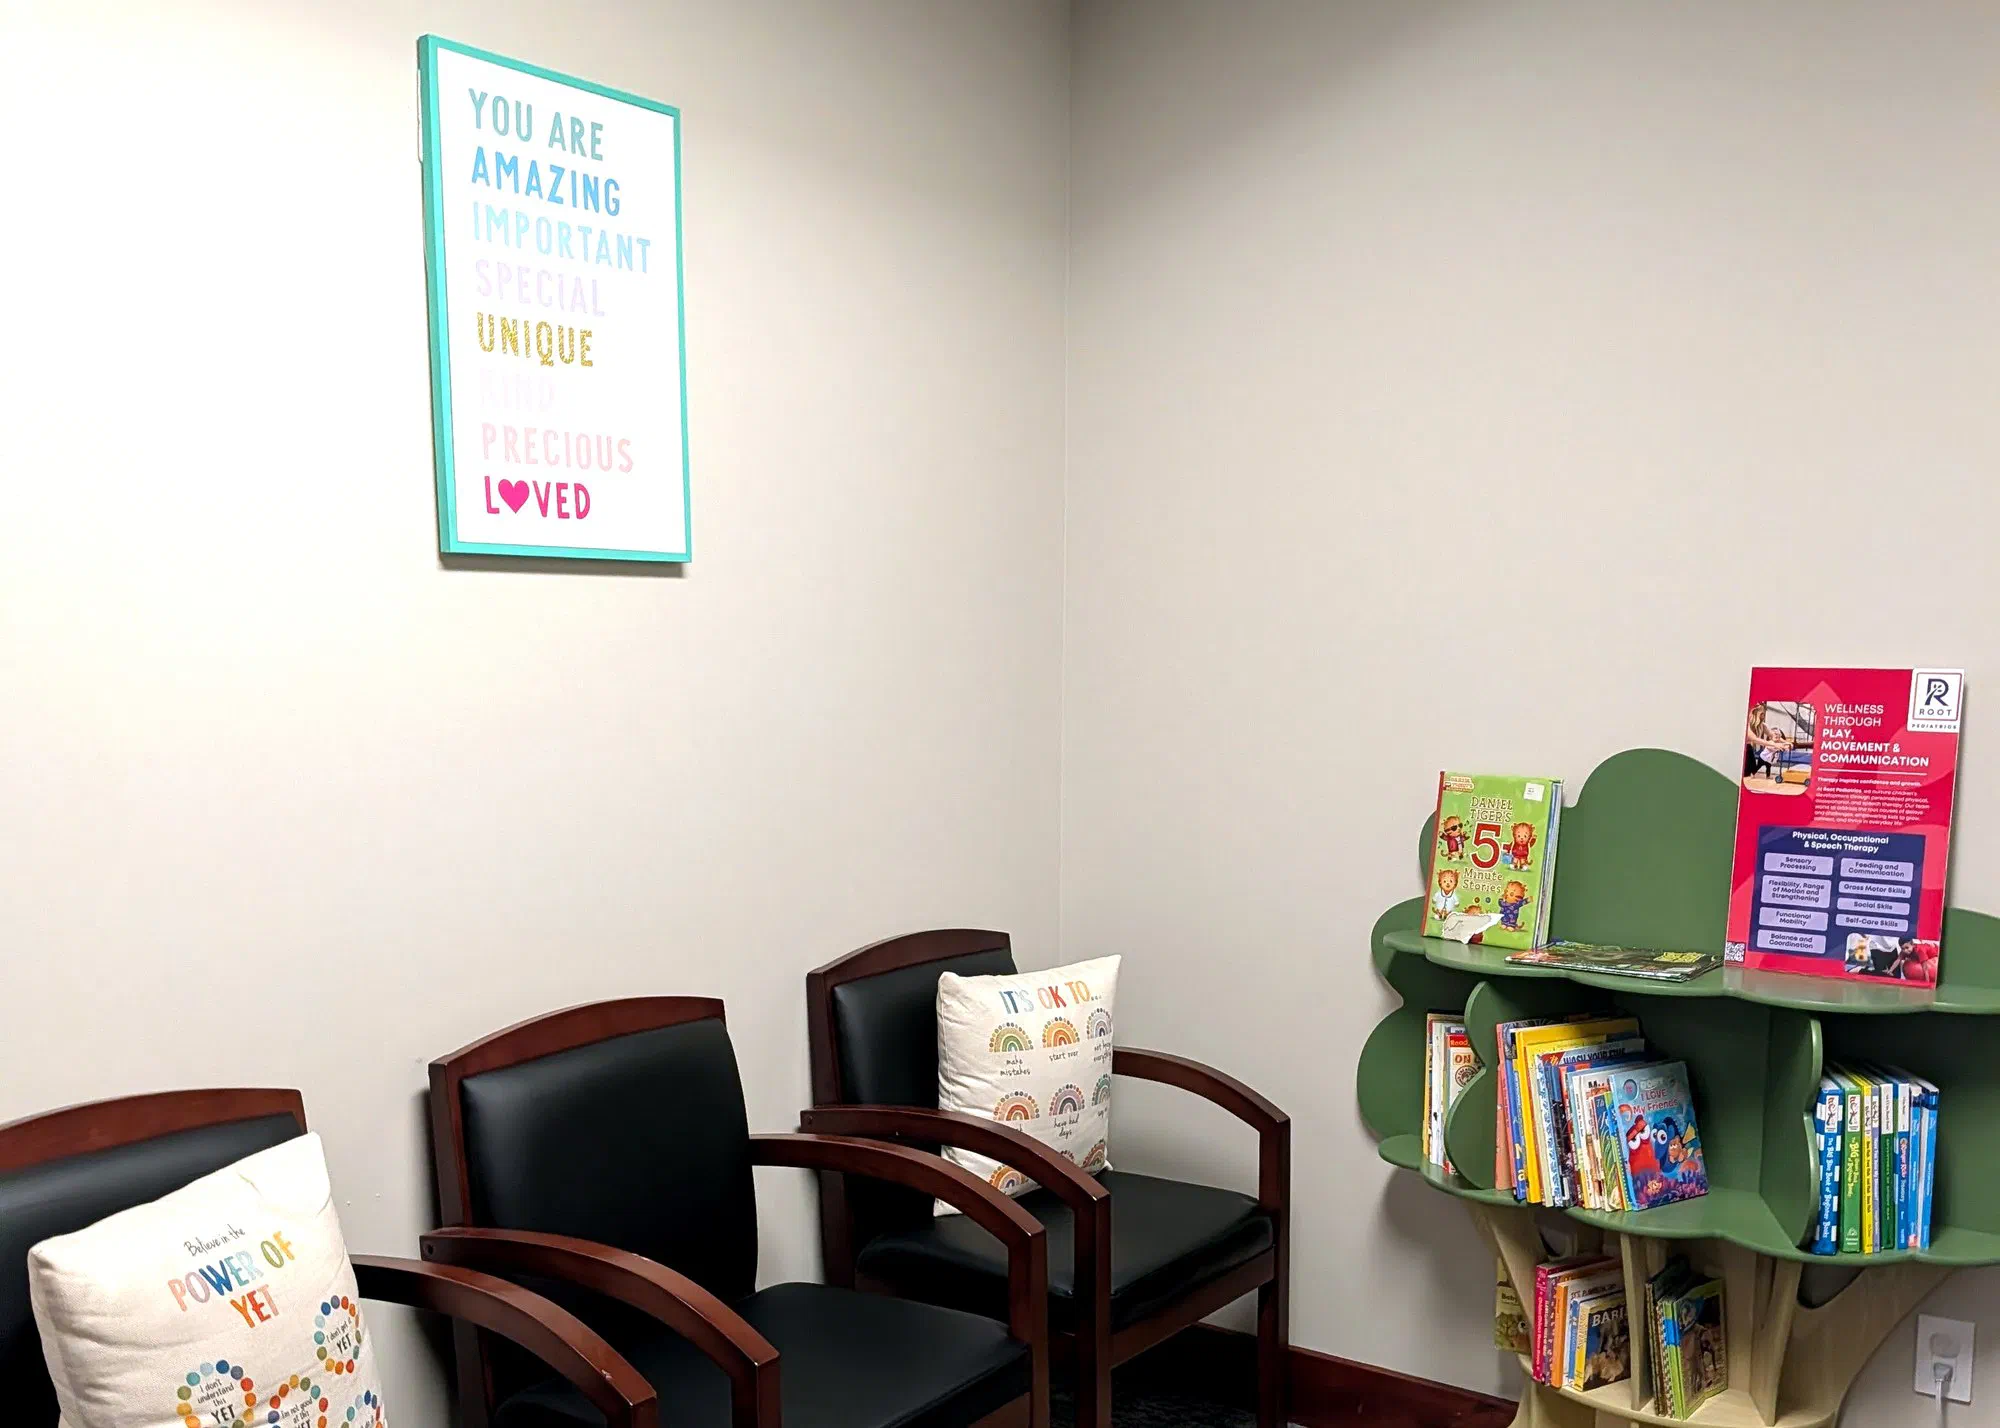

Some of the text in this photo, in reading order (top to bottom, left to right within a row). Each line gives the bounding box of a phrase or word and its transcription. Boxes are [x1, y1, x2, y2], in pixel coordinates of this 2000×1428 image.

[469, 88, 603, 161] YOU ARE
[471, 146, 620, 216] AMAZING
[473, 202, 651, 273] IMPORTANT
[476, 259, 605, 316] SPECIAL
[477, 312, 593, 367] UNIQUE
[481, 422, 634, 473] PRECIOUS
[1824, 703, 1884, 714] WELLNESS
[1919, 708, 1952, 716] ROOT
[1824, 716, 1881, 726] THROUGH
[1822, 728, 1855, 739] PLAY,
[1821, 741, 1900, 753] MOVEMENT &
[1820, 753, 1929, 767] COMMUNICATION
[1472, 797, 1512, 810] DANIEL
[1470, 809, 1512, 822] TIGER'S
[1792, 831, 1889, 845] Physical, Occupational
[1811, 841, 1842, 850] Speech
[1844, 844, 1879, 854] Therapy
[1780, 863, 1816, 872] Processing
[1786, 857, 1812, 865] Sensory
[1856, 862, 1883, 870] Feeding
[1464, 868, 1502, 880] Minute
[1848, 867, 1904, 877] Communication
[1463, 880, 1501, 893] Stories
[1768, 880, 1801, 888] Flexibility,
[1772, 893, 1819, 903] Strengthening
[1776, 911, 1812, 919] Functional
[1846, 917, 1878, 925] Self-Care
[1779, 918, 1807, 926] Mobility
[1769, 940, 1813, 948] Coordination
[999, 989, 1034, 1014] IT'S
[1037, 986, 1067, 1009] OK
[1006, 1055, 1023, 1065] make
[1049, 1053, 1066, 1062] start
[1455, 1054, 1471, 1063] ON
[1000, 1065, 1031, 1076] mistakes
[1646, 1089, 1667, 1100] LOVE
[1633, 1099, 1678, 1114] My Friends
[1850, 1143, 1859, 1158] BIG
[1825, 1172, 1833, 1186] Book
[1823, 1194, 1832, 1219] Beginner
[184, 1224, 245, 1256] Believe in the
[168, 1231, 295, 1312] POWER OF
[230, 1284, 279, 1328] YET
[336, 1334, 352, 1354] YET
[200, 1379, 222, 1393] I don't
[197, 1383, 235, 1404] understand
[213, 1398, 226, 1407] this
[291, 1404, 299, 1414] not
[211, 1404, 235, 1424] YET
[293, 1411, 309, 1424] at this
